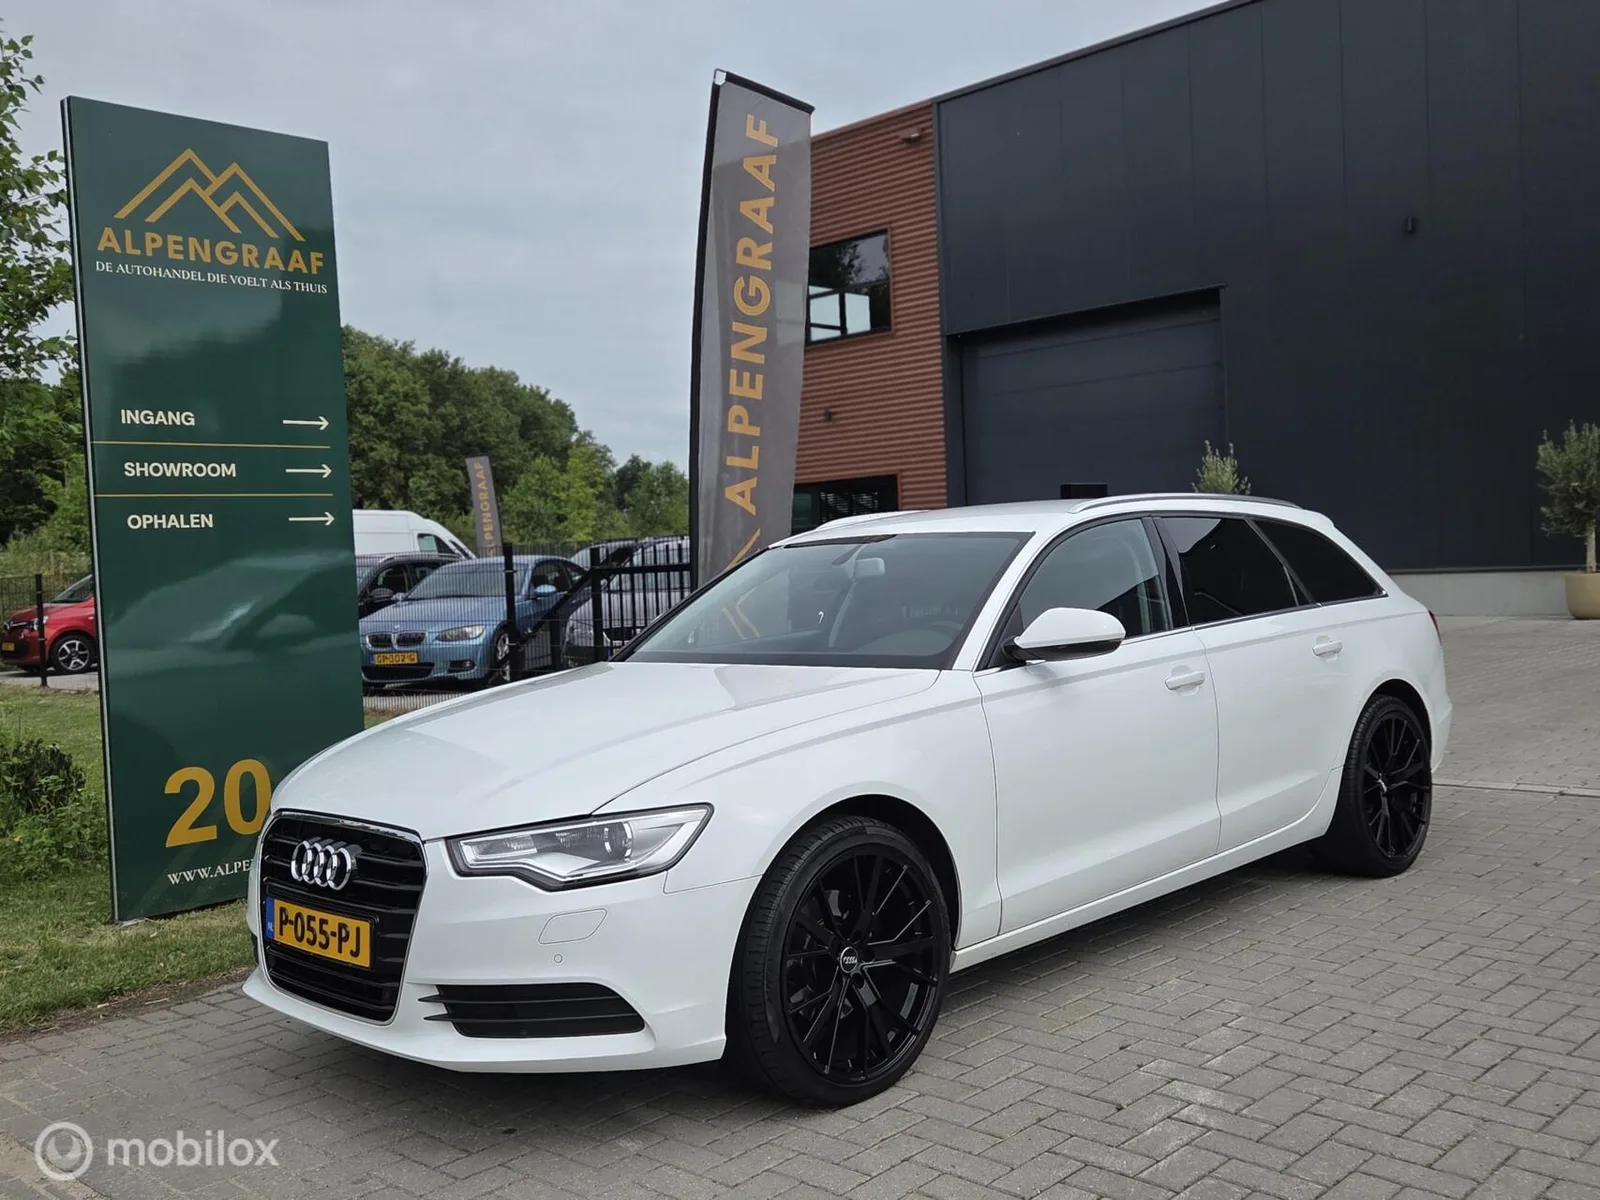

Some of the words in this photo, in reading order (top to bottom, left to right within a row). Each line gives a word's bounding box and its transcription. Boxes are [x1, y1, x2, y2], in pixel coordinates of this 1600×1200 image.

[97, 227, 324, 275] ALPENGRAAF
[95, 260, 113, 273] DE
[115, 264, 206, 282] AUTOHANDEL
[207, 272, 228, 284] DIE
[229, 274, 268, 288] VOELT
[270, 279, 292, 291] ALS
[293, 282, 328, 294] THUIS
[724, 112, 779, 517] ALPENGRAAF
[120, 409, 196, 427] INGANG
[123, 461, 237, 478] SHOWROOM
[127, 513, 214, 530] OPHALEN
[164, 758, 272, 848] 20
[167, 858, 253, 885] WWW.ALPE
[278, 906, 361, 958] P-055-PJ
